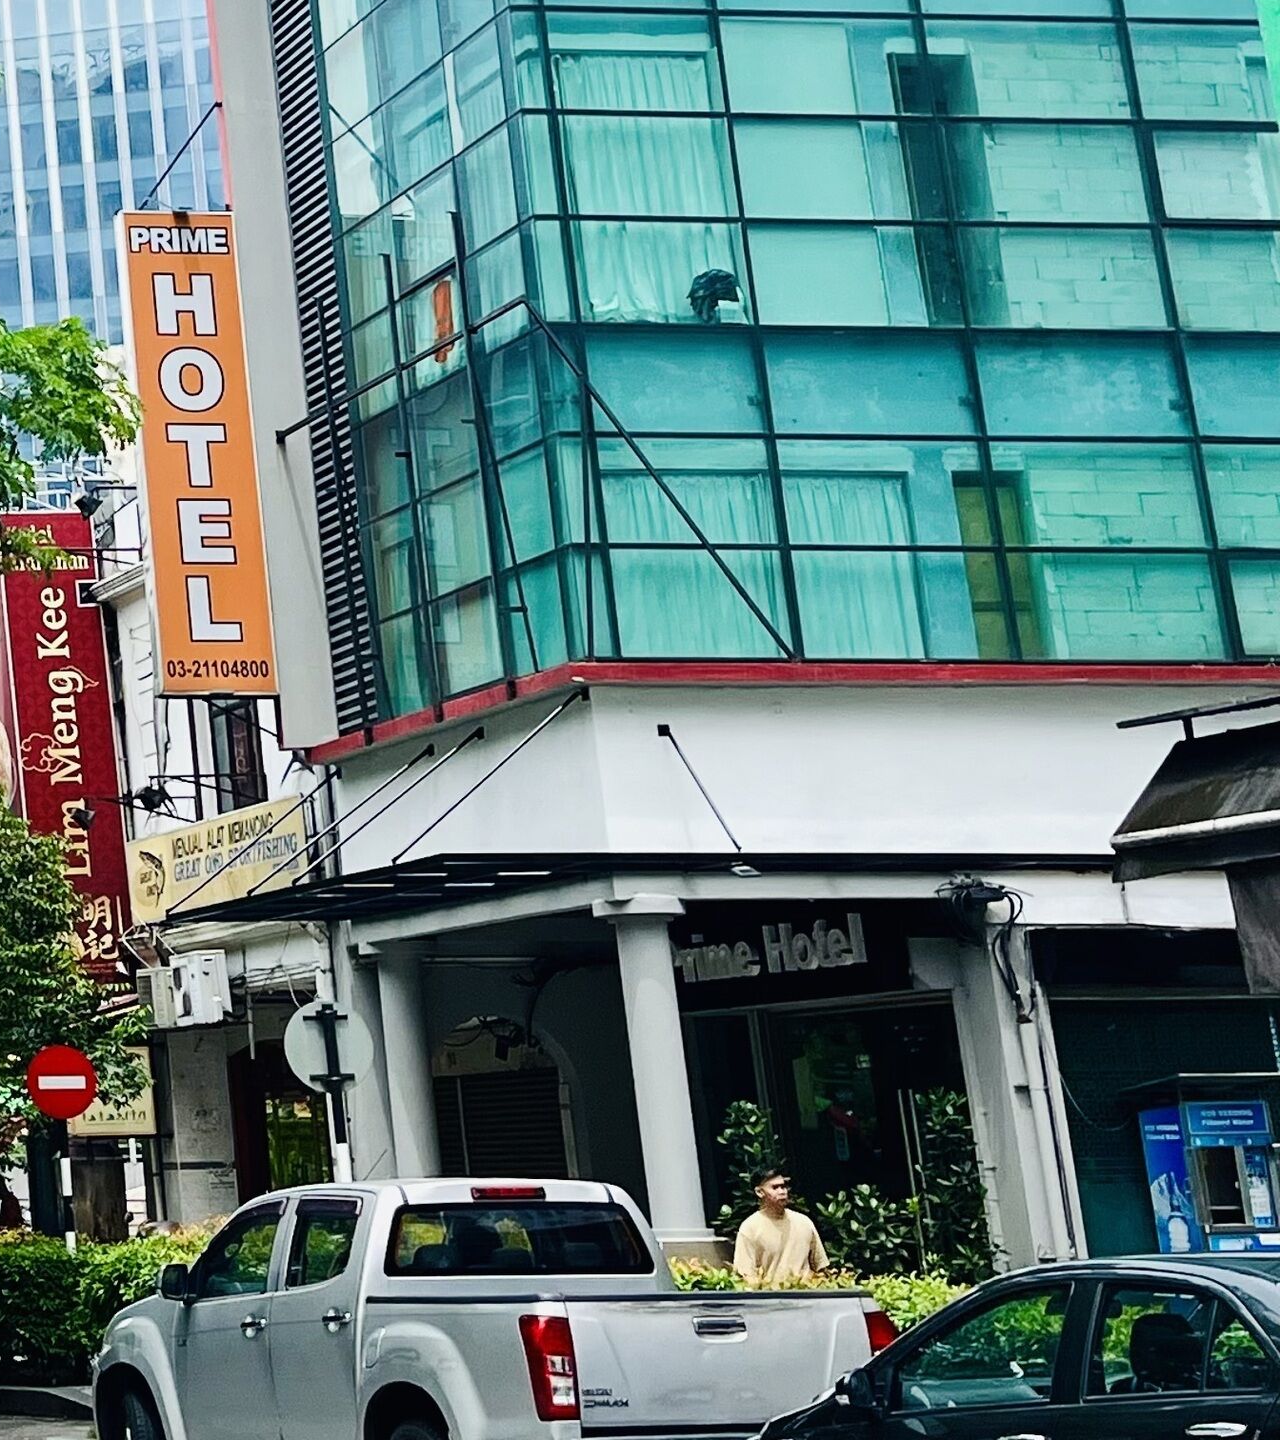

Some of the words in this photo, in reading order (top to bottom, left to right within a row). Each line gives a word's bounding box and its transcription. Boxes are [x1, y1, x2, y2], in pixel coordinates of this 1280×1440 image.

[130, 226, 230, 255] PRIME
[152, 272, 244, 642] HOTEL
[35, 586, 70, 660] Kee
[167, 658, 269, 679] 03-21104800
[47, 669, 83, 786] Meng
[61, 797, 92, 877] Lim
[762, 913, 869, 974] Hotel
